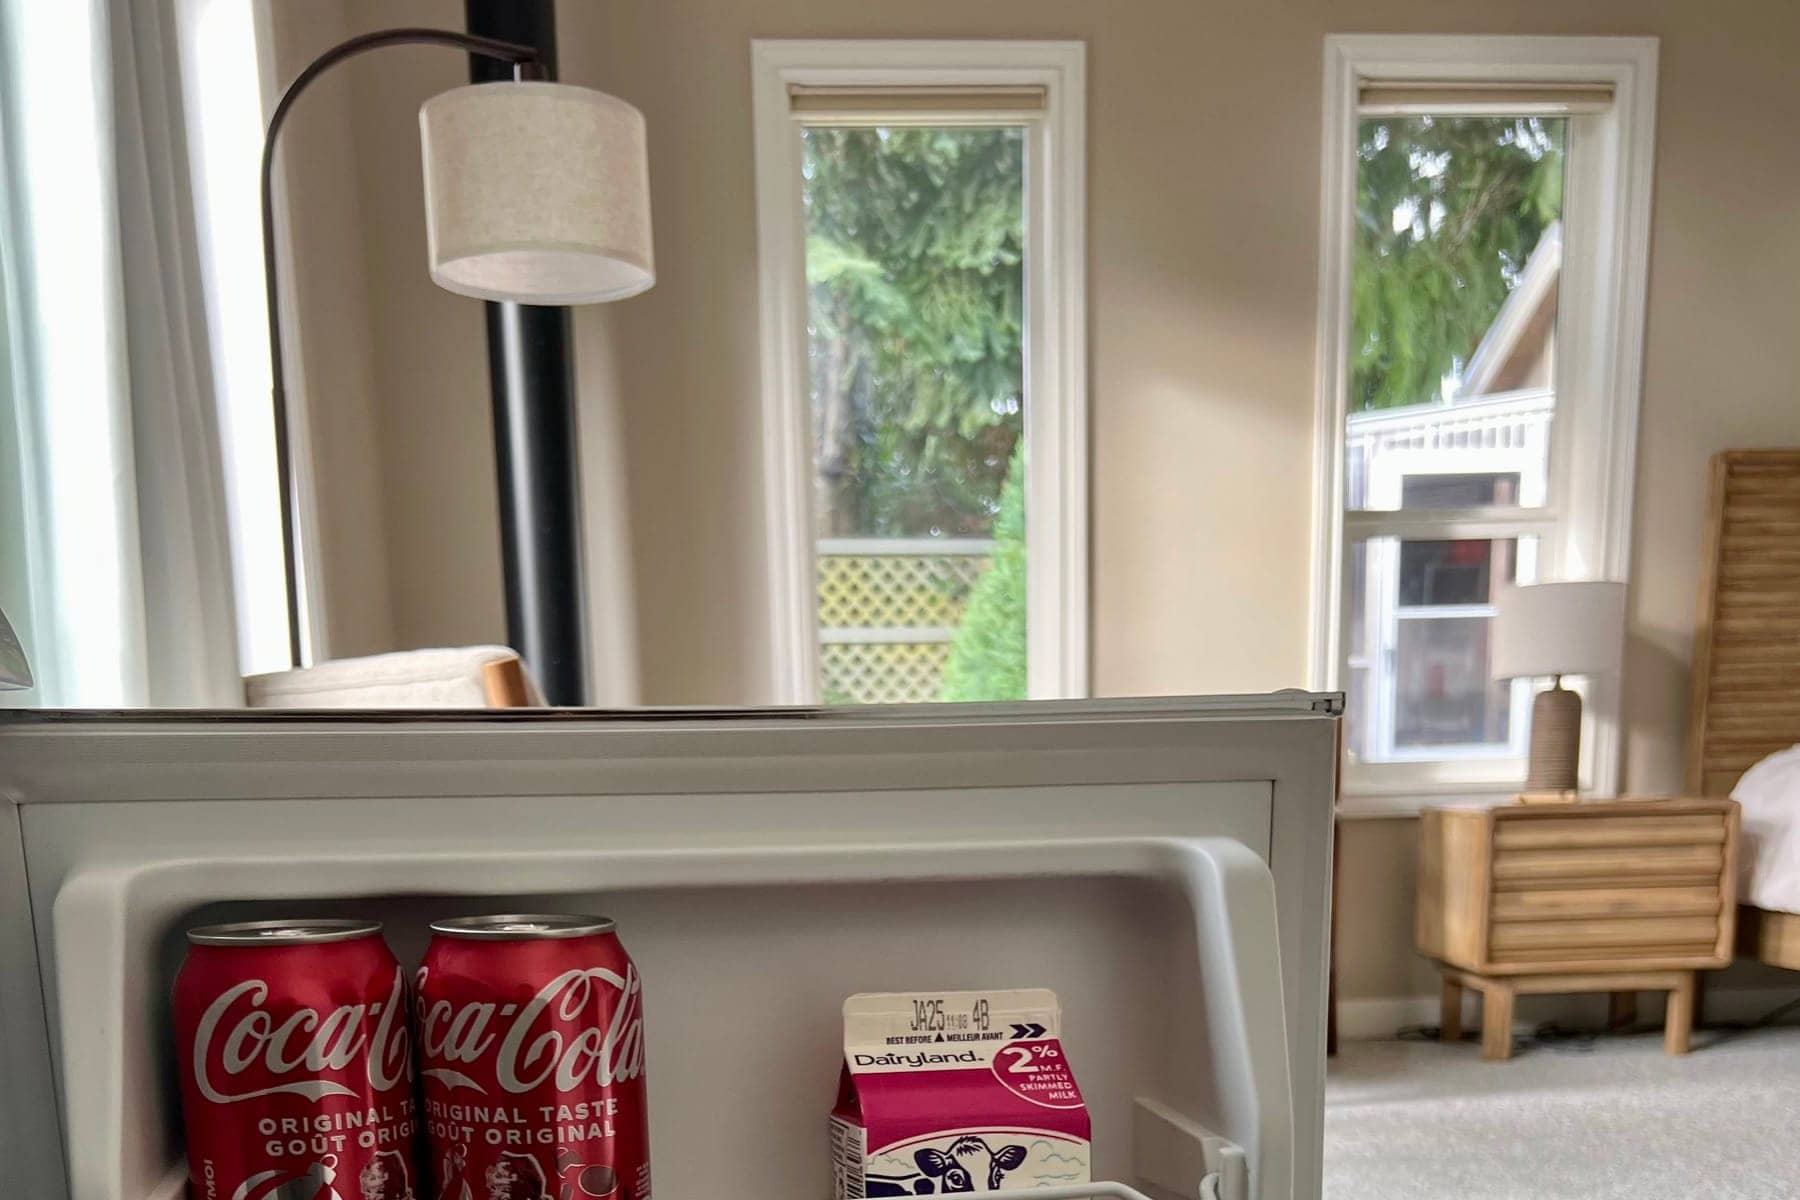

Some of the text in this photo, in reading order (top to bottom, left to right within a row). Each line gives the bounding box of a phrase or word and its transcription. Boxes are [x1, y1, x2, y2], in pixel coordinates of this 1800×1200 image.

[909, 998, 946, 1031] JA25
[971, 998, 991, 1031] 4B
[886, 1030, 1004, 1046] BEST BEFORE MEILLEUR AVANT
[1002, 1044, 1059, 1074] 2%
[1039, 1063, 1067, 1072] M.F.
[1019, 1082, 1073, 1091] SKIMMED
[1028, 1074, 1069, 1082] PARTLY
[1048, 1090, 1077, 1100] MILK
[258, 1107, 393, 1136] ORIGINAL
[539, 1098, 618, 1123] TASTE
[485, 1120, 616, 1145] ORIGINAL
[265, 1134, 347, 1157] GOÛT
